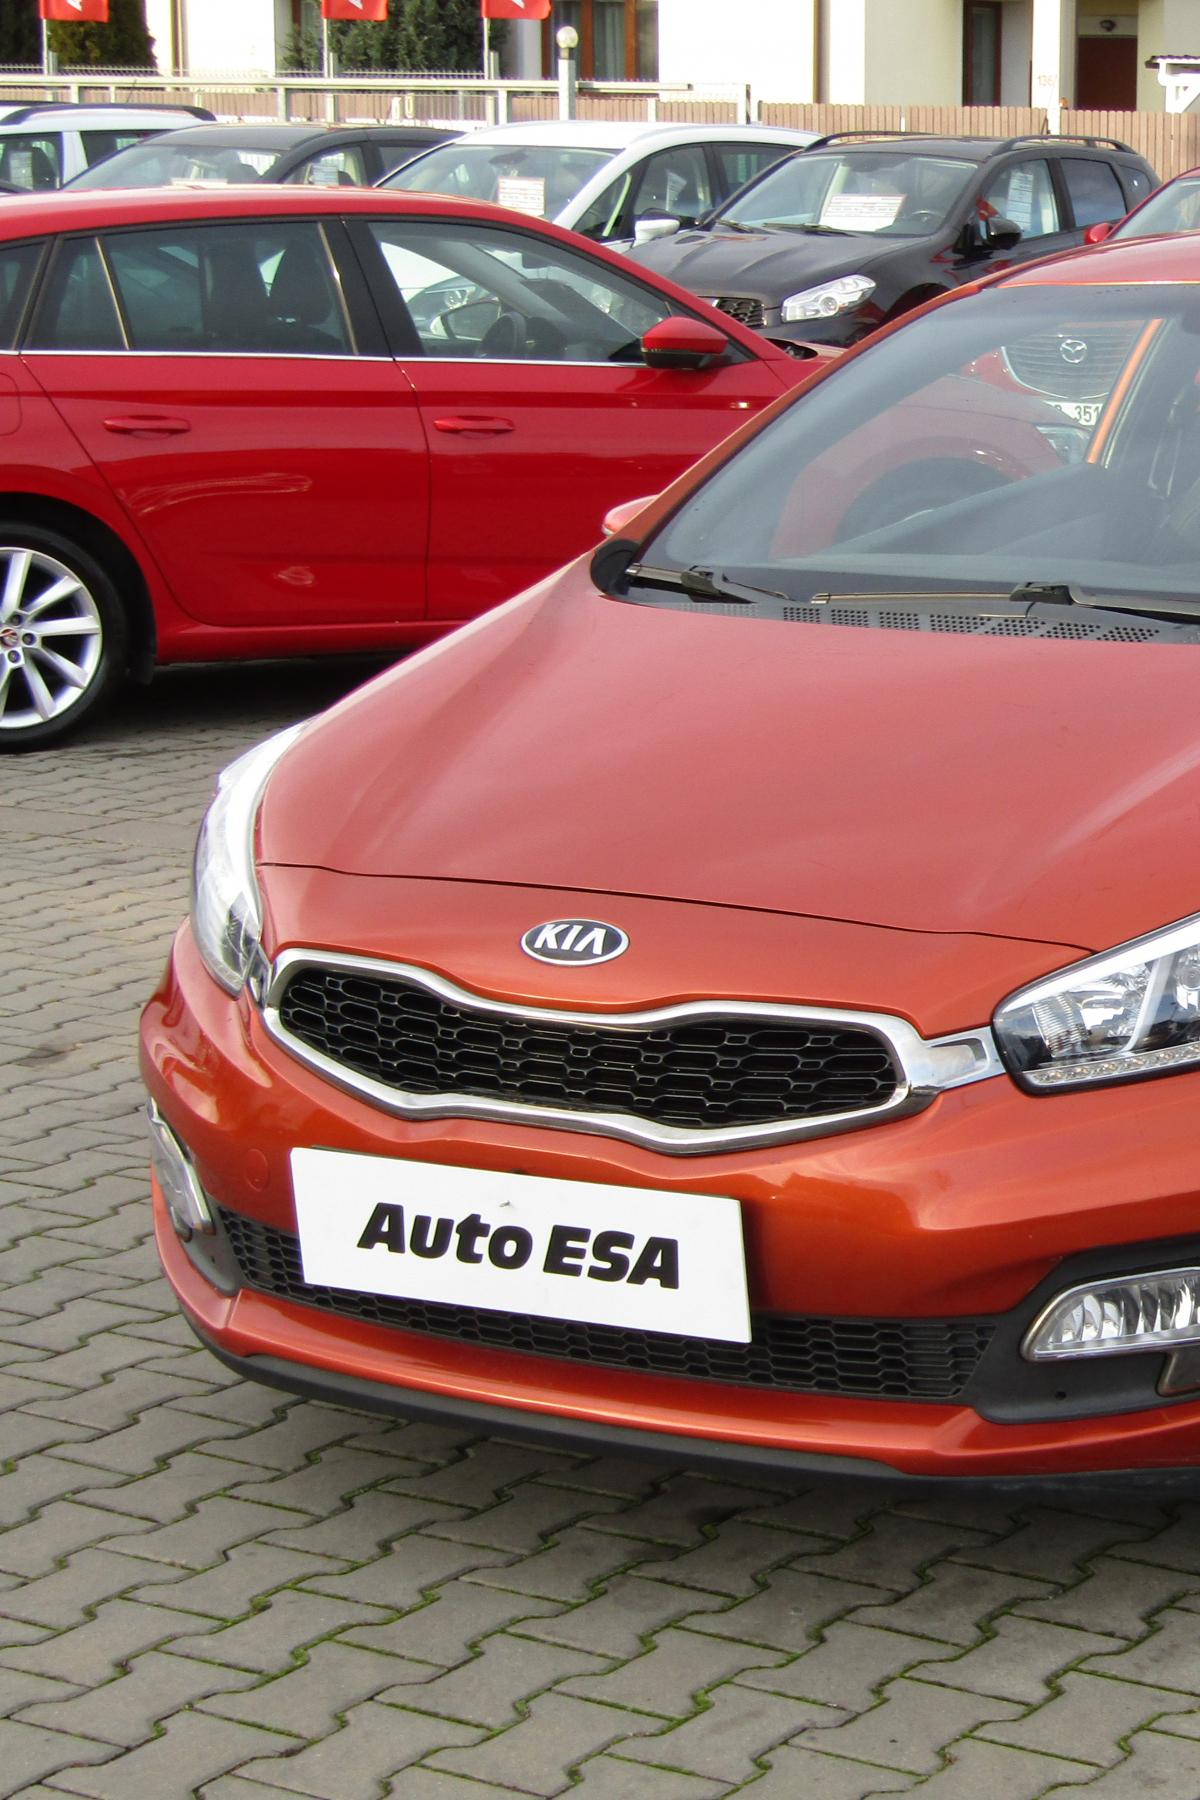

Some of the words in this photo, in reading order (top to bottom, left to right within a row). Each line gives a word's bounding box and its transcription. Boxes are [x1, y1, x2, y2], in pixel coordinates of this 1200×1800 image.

[533, 924, 607, 955] KIA
[356, 1202, 533, 1270] Auto
[542, 1224, 679, 1290] ESA
